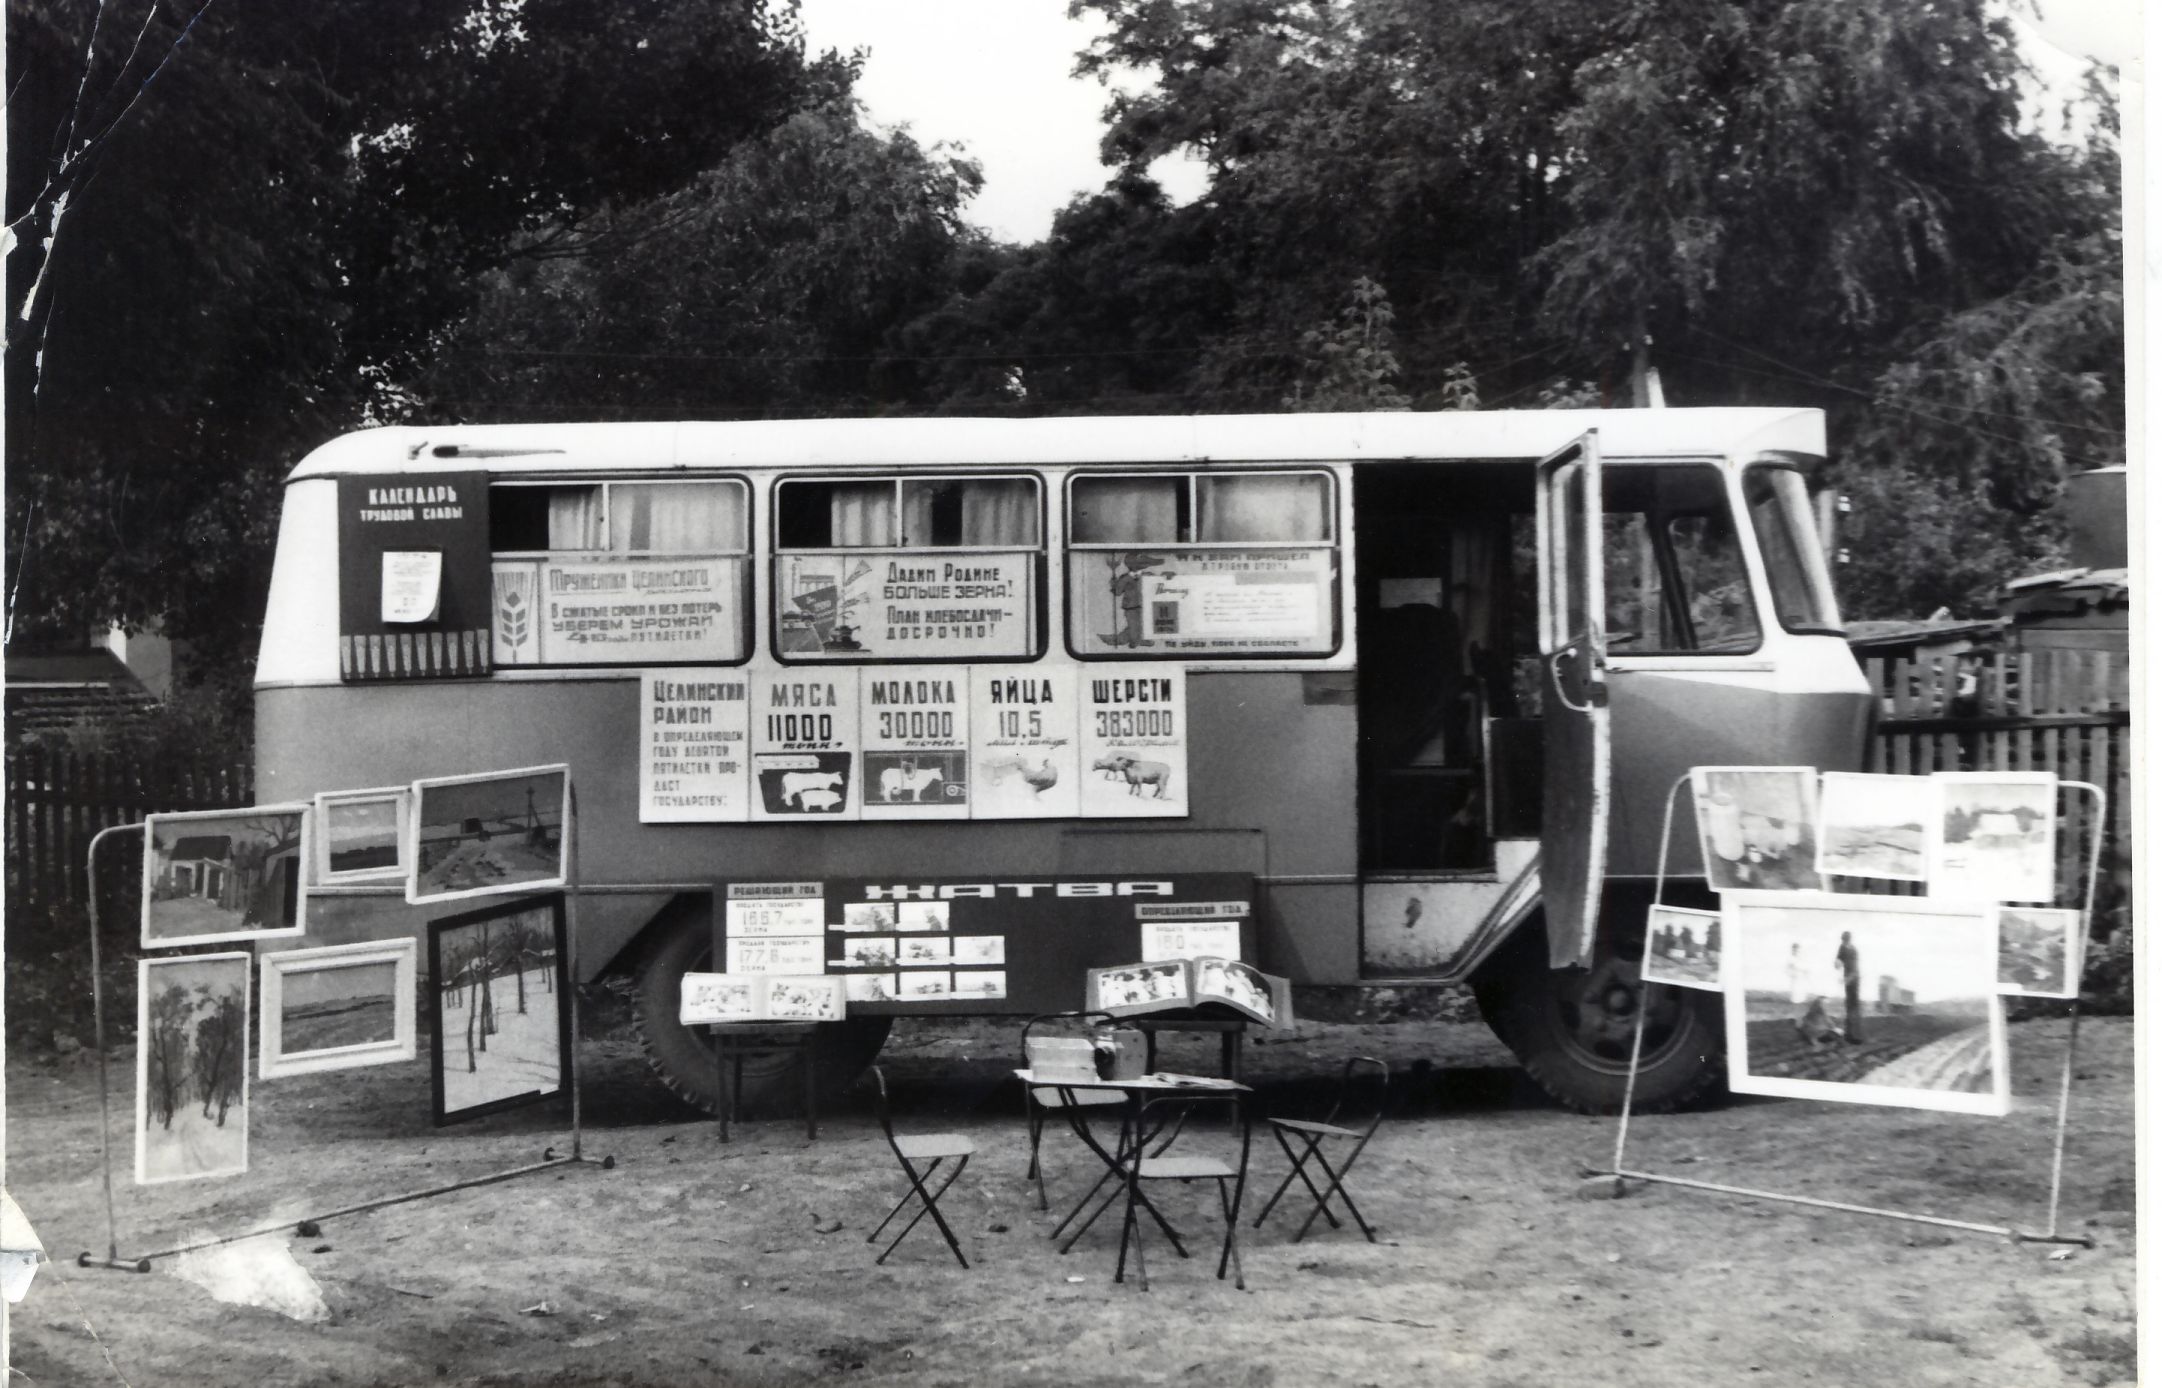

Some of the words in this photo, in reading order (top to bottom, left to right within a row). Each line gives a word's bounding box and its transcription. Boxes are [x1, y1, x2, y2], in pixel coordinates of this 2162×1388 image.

[369, 486, 457, 505] КАЛЕНДАРЬ
[360, 507, 414, 521] ТРУДОВОЙ
[423, 506, 462, 520] СЛАВЫ
[883, 586, 951, 599] БОЛЬШЕ
[955, 579, 1013, 599] ЗЕРНА!
[659, 604, 679, 615] БЕЗ
[681, 602, 722, 614] ПОТЕРЬ
[887, 605, 921, 624] ПЛАН
[552, 619, 623, 632] УБЕРЕМ
[886, 623, 995, 640] ДОСРОЧНО!
[770, 683, 837, 707] МЯСА
[872, 680, 956, 704] МОЛОКА
[991, 676, 1054, 705] ЯЙЦА
[1092, 679, 1171, 704] ШЕРСТИ
[653, 704, 712, 724] РАЙОН
[768, 714, 832, 742] 11000
[880, 711, 953, 739] 30000
[1096, 710, 1173, 738] 383000
[653, 746, 678, 757] ГОДУ
[653, 780, 680, 791] ДАСТ
[799, 885, 816, 895] ГОД
[865, 881, 1174, 899] ЖАТВА
